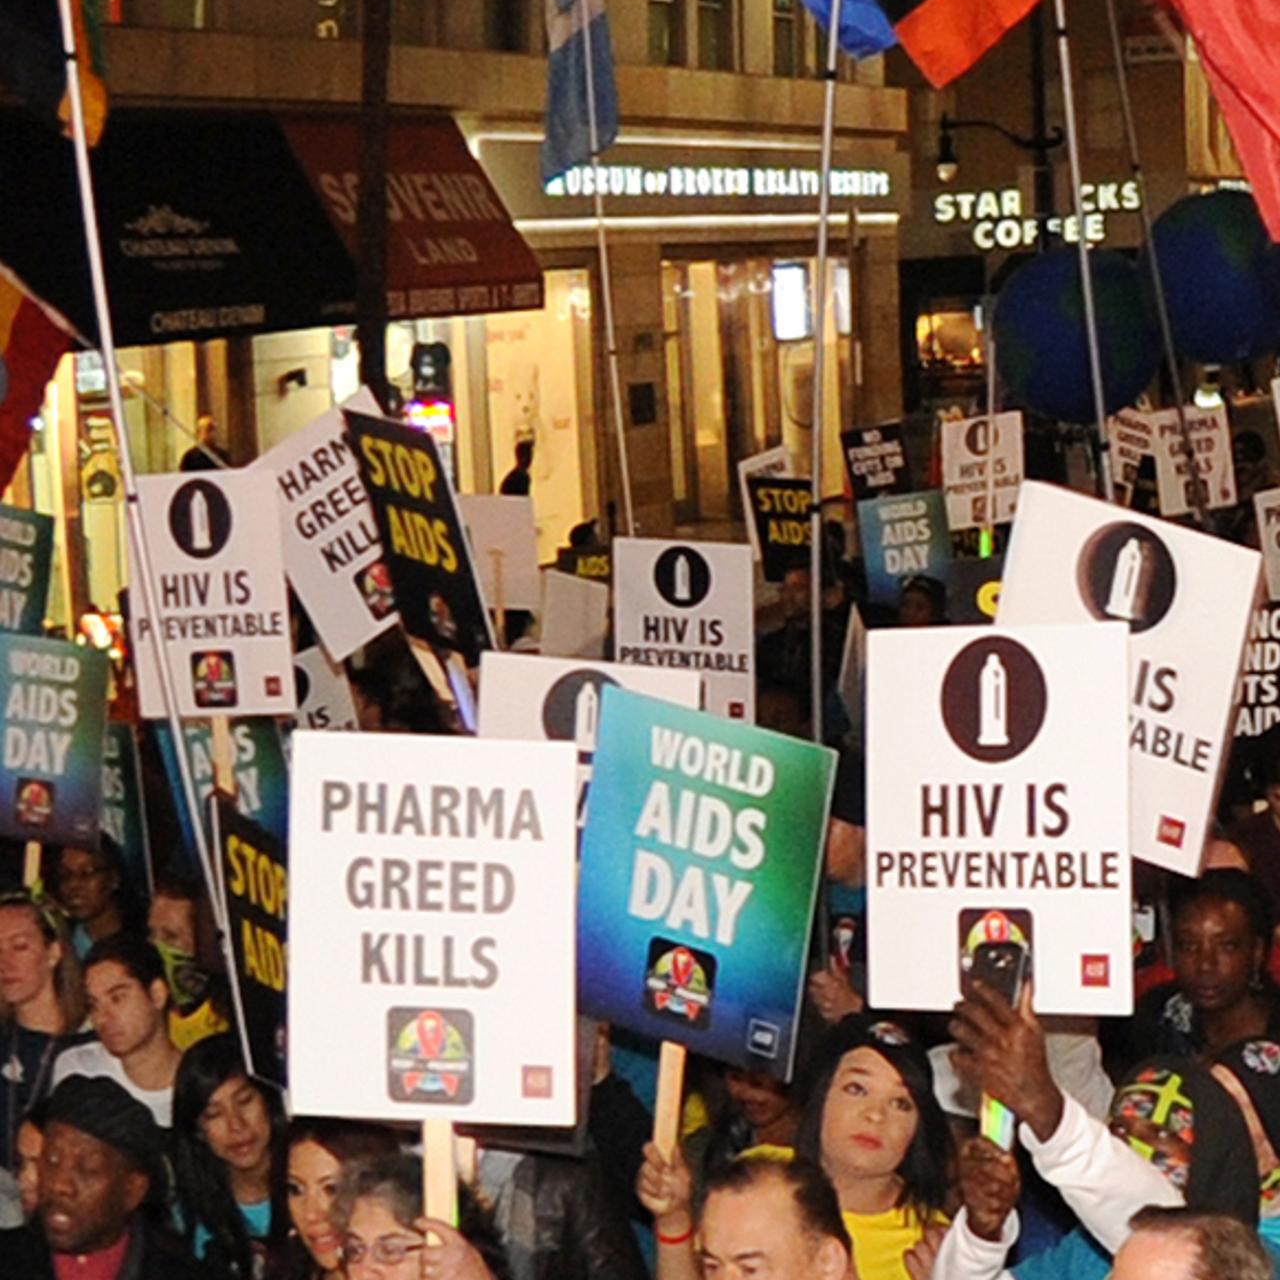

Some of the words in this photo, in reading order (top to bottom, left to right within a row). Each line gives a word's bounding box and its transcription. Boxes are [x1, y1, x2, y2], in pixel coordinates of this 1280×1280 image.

[753, 169, 890, 196] RELATINSHIPS
[934, 181, 1142, 222] STARCKS
[277, 431, 351, 502] HARM
[362, 436, 437, 503] STOP
[295, 476, 368, 541] GREE
[757, 488, 812, 514] STOP
[320, 520, 384, 574] KILL
[387, 505, 458, 573] AIDS
[881, 520, 931, 546] AIDS
[884, 545, 930, 575] DAY
[161, 572, 211, 609] HIV
[224, 570, 251, 606] IS
[138, 612, 283, 642] PEVENTABLE
[643, 616, 688, 644] HIV
[699, 618, 724, 646] IS
[8, 649, 80, 682] WORLD
[620, 646, 749, 672] PREVENTABLE
[5, 687, 79, 726] AIDS
[1133, 659, 1178, 713] IS
[1235, 672, 1279, 704] TS
[2, 730, 74, 775] DAY
[651, 724, 775, 798] WORLD
[320, 780, 544, 842] PHARMA
[634, 780, 768, 870] AIDS
[920, 782, 1004, 839] HIV
[1025, 782, 1070, 839] IS
[345, 856, 516, 914] GREED
[875, 851, 1120, 889] PREVENTABLE
[627, 848, 755, 947] DAY
[241, 919, 288, 992] AID
[359, 931, 499, 989] KILLS
